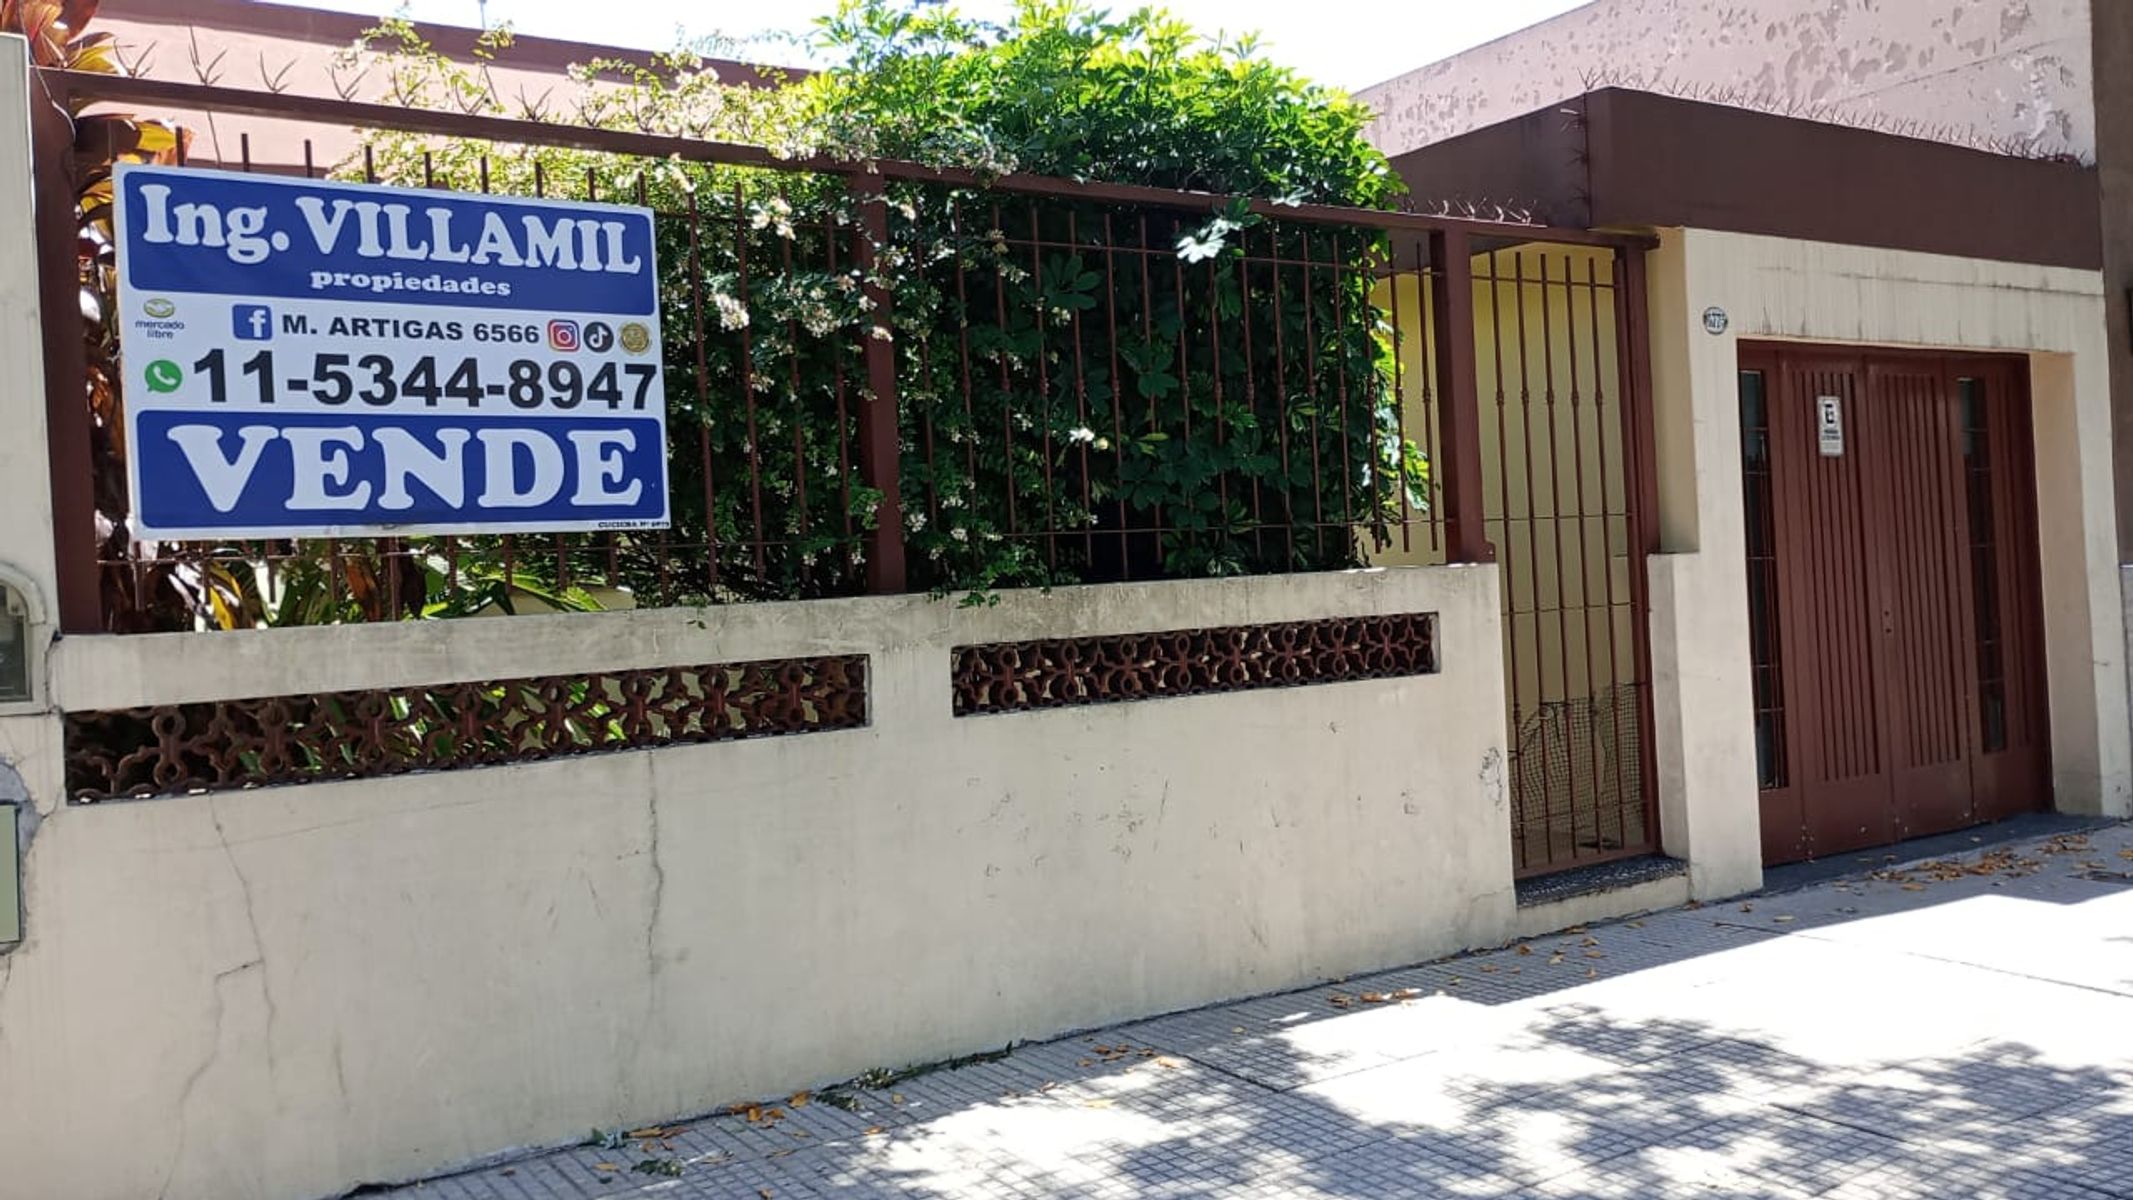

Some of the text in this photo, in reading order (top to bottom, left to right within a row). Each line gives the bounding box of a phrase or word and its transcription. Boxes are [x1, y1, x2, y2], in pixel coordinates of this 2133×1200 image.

[139, 184, 641, 274] Ing. VILLAMIL
[310, 271, 511, 296] propiedades
[135, 320, 184, 329] mercado
[147, 329, 174, 339] libre
[282, 314, 540, 343] M. ARTIGAS 6566
[194, 348, 657, 410] 11-5344-8947
[167, 424, 642, 512] VENDE
